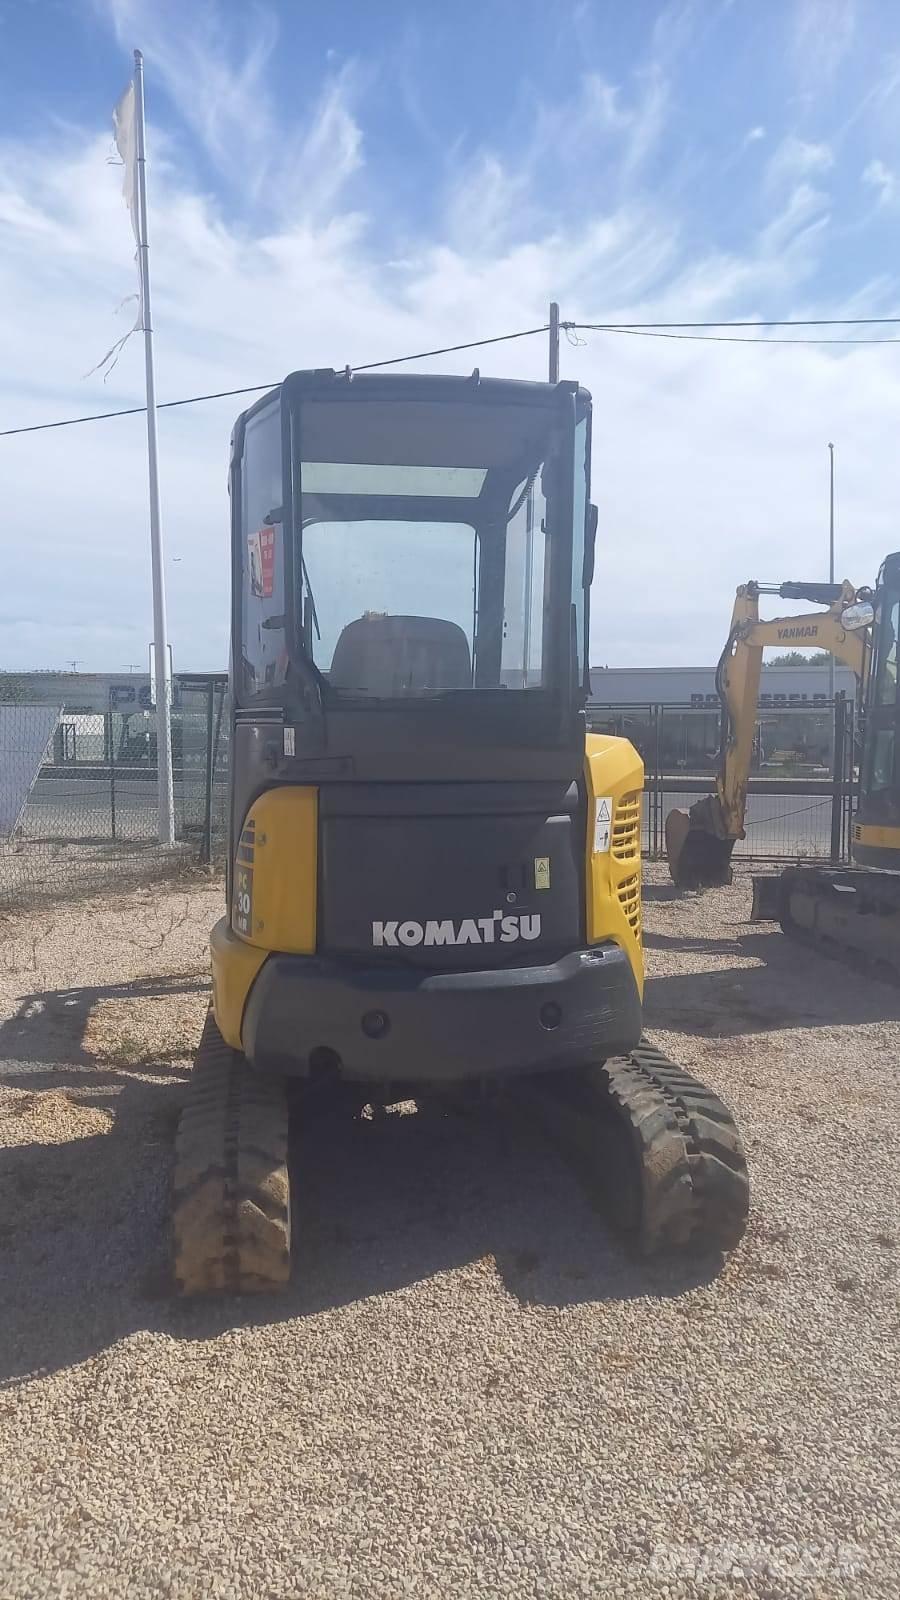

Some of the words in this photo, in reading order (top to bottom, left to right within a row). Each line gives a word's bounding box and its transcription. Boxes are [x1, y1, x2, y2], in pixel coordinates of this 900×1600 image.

[777, 625, 819, 640] YANMAR
[238, 891, 251, 914] 30
[372, 909, 541, 946] KOMATSU
